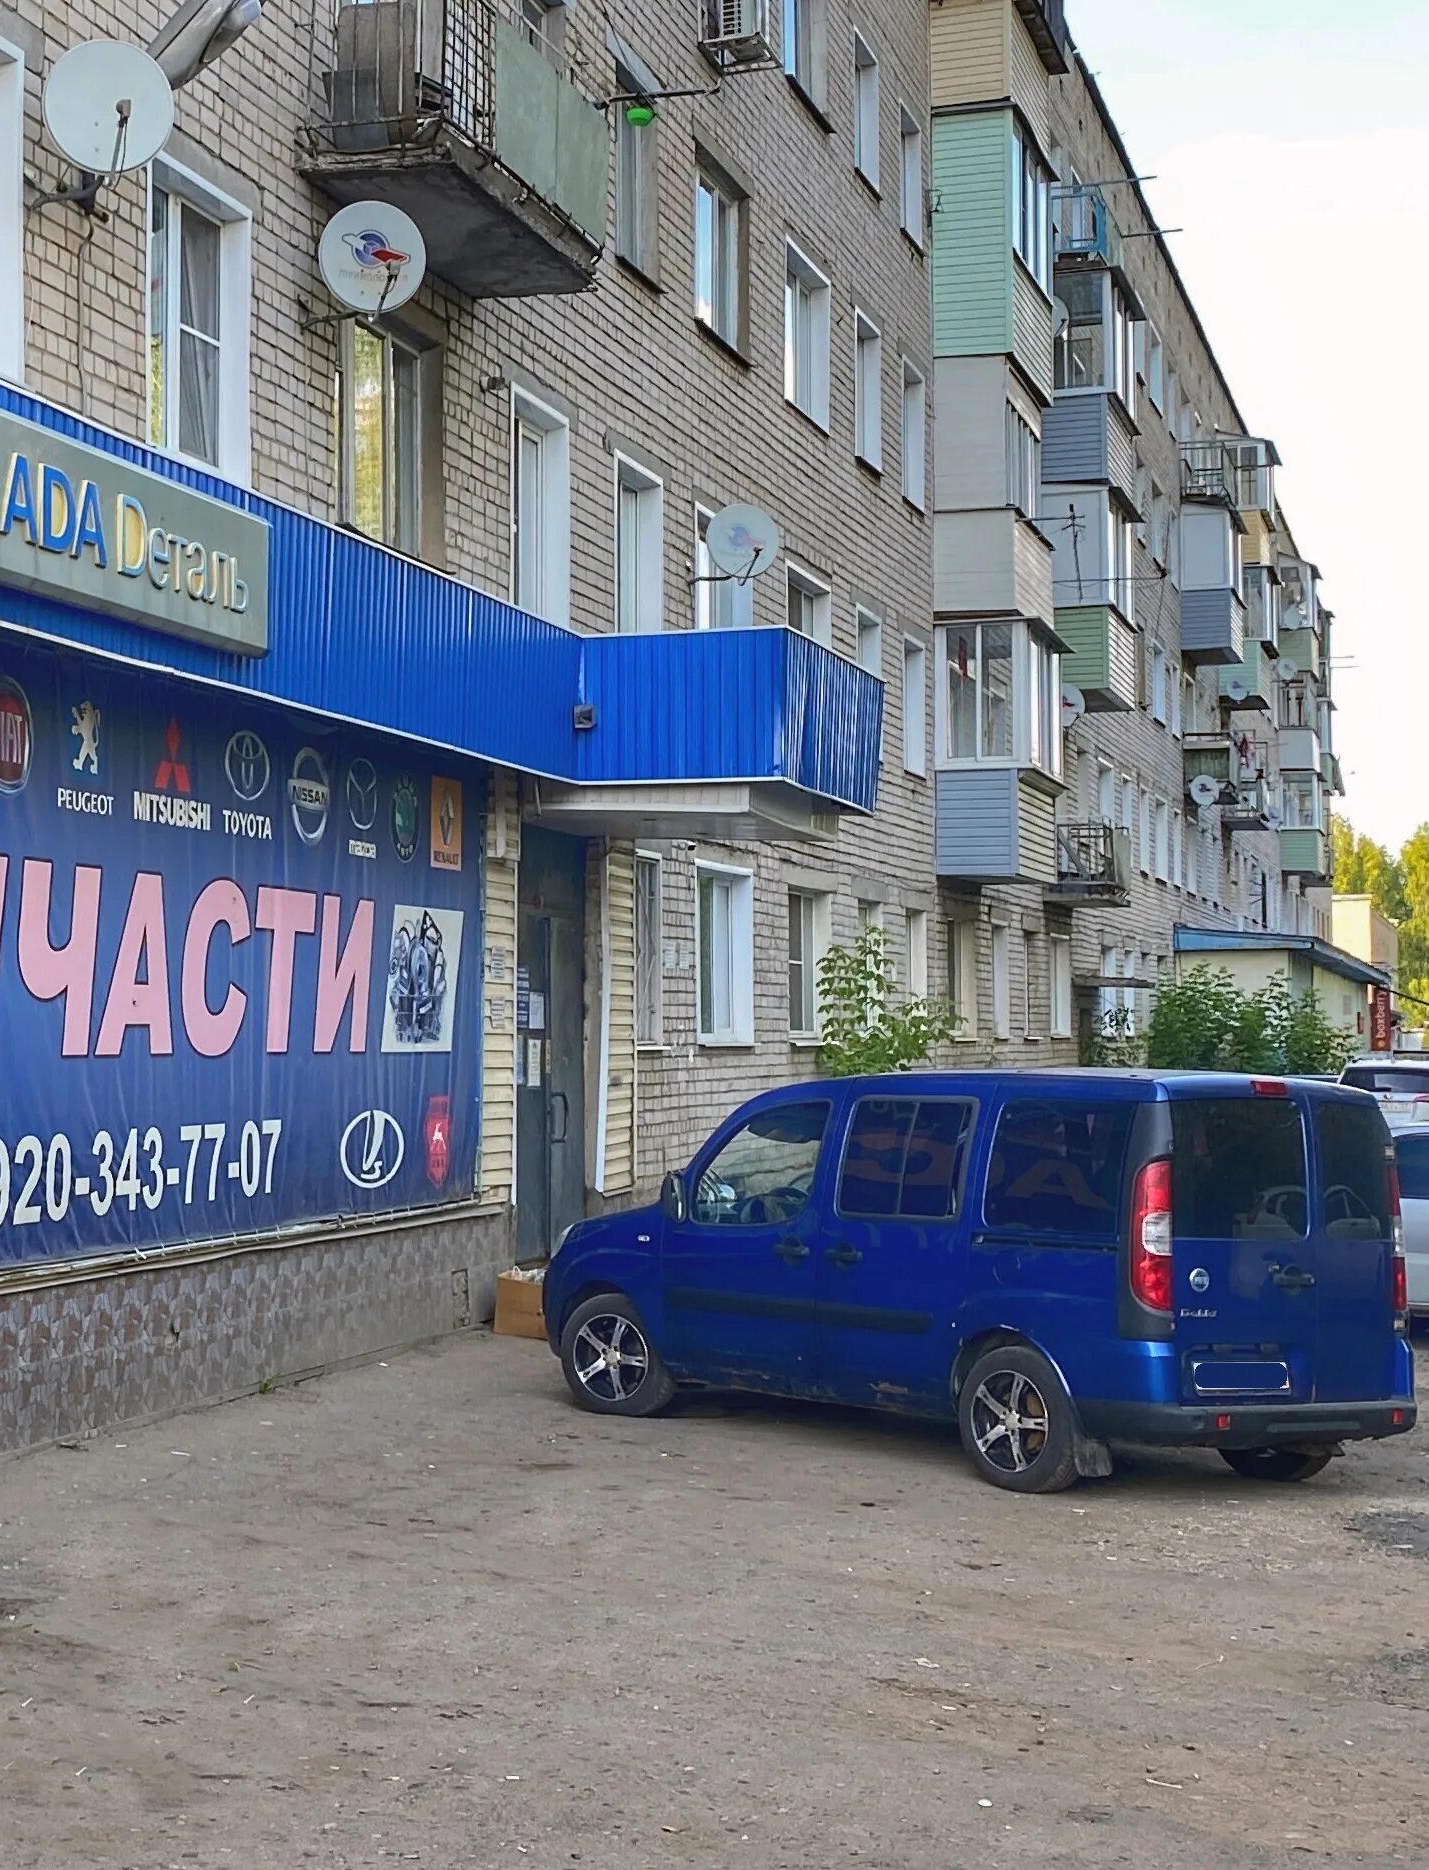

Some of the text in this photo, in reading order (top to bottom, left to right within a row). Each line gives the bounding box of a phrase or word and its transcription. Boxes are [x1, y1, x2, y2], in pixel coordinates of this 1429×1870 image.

[57, 787, 114, 816] PEUGEOT
[292, 785, 328, 805] NISSAN
[133, 791, 211, 831] MITSUBISHI
[223, 809, 272, 840] TOYOTA
